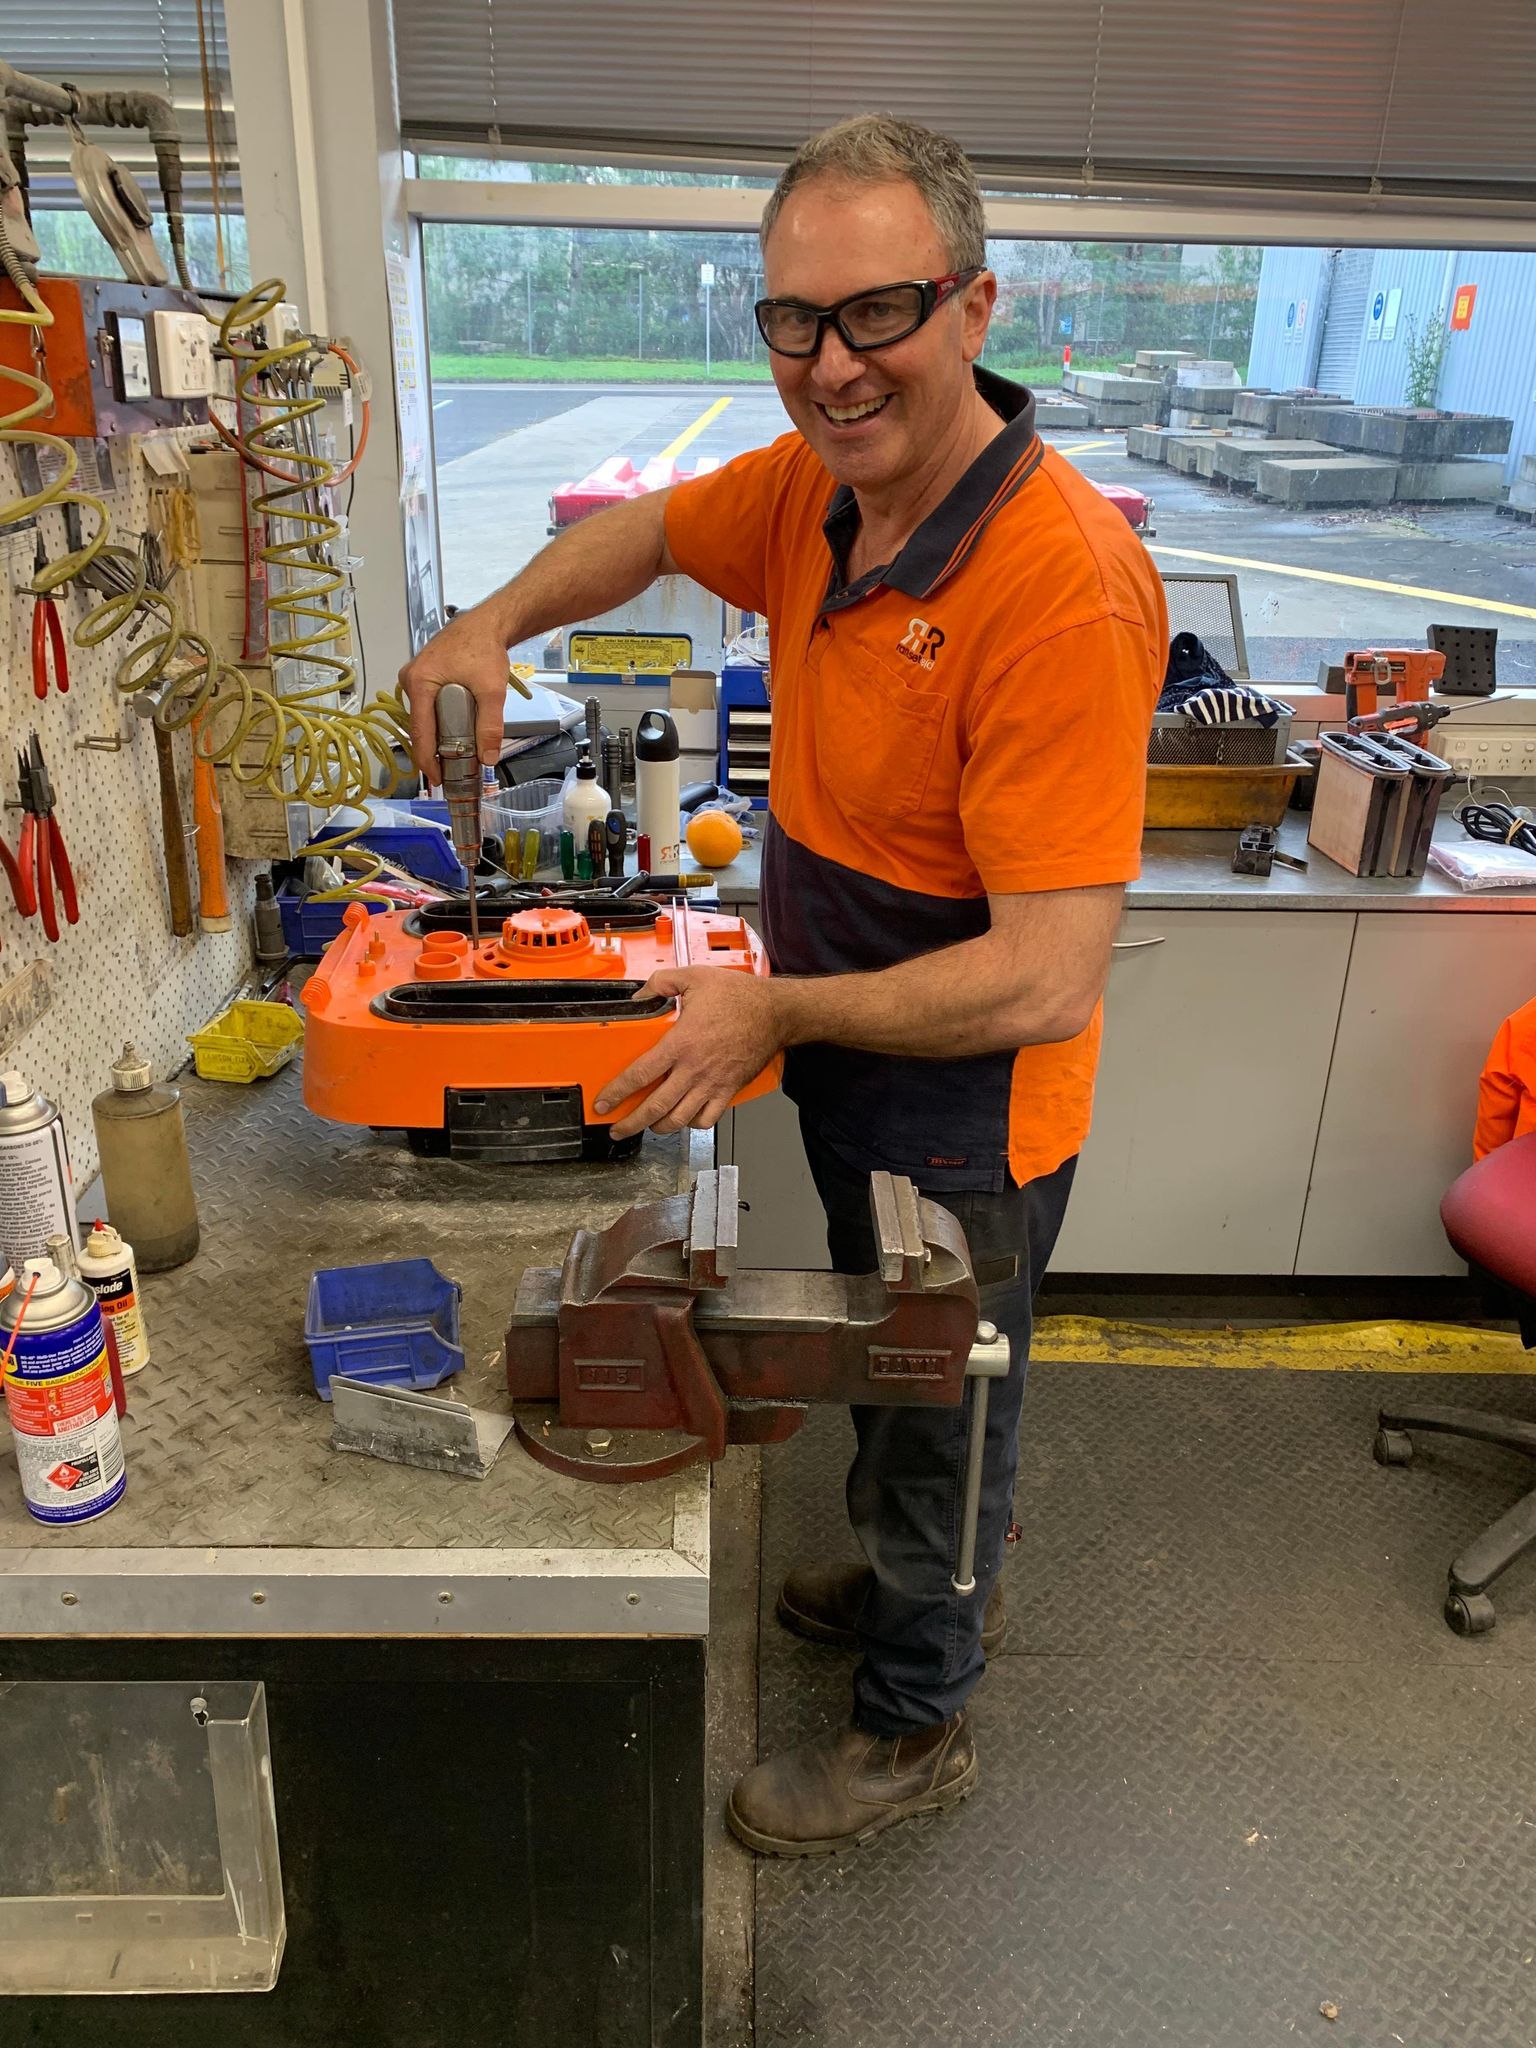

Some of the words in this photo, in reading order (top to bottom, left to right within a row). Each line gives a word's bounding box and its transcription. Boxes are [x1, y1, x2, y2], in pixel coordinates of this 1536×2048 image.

[94, 1280, 123, 1295] slode
[101, 1303, 115, 1314] ing
[117, 1299, 128, 1310] Oil
[45, 1377, 67, 1386] BASIC
